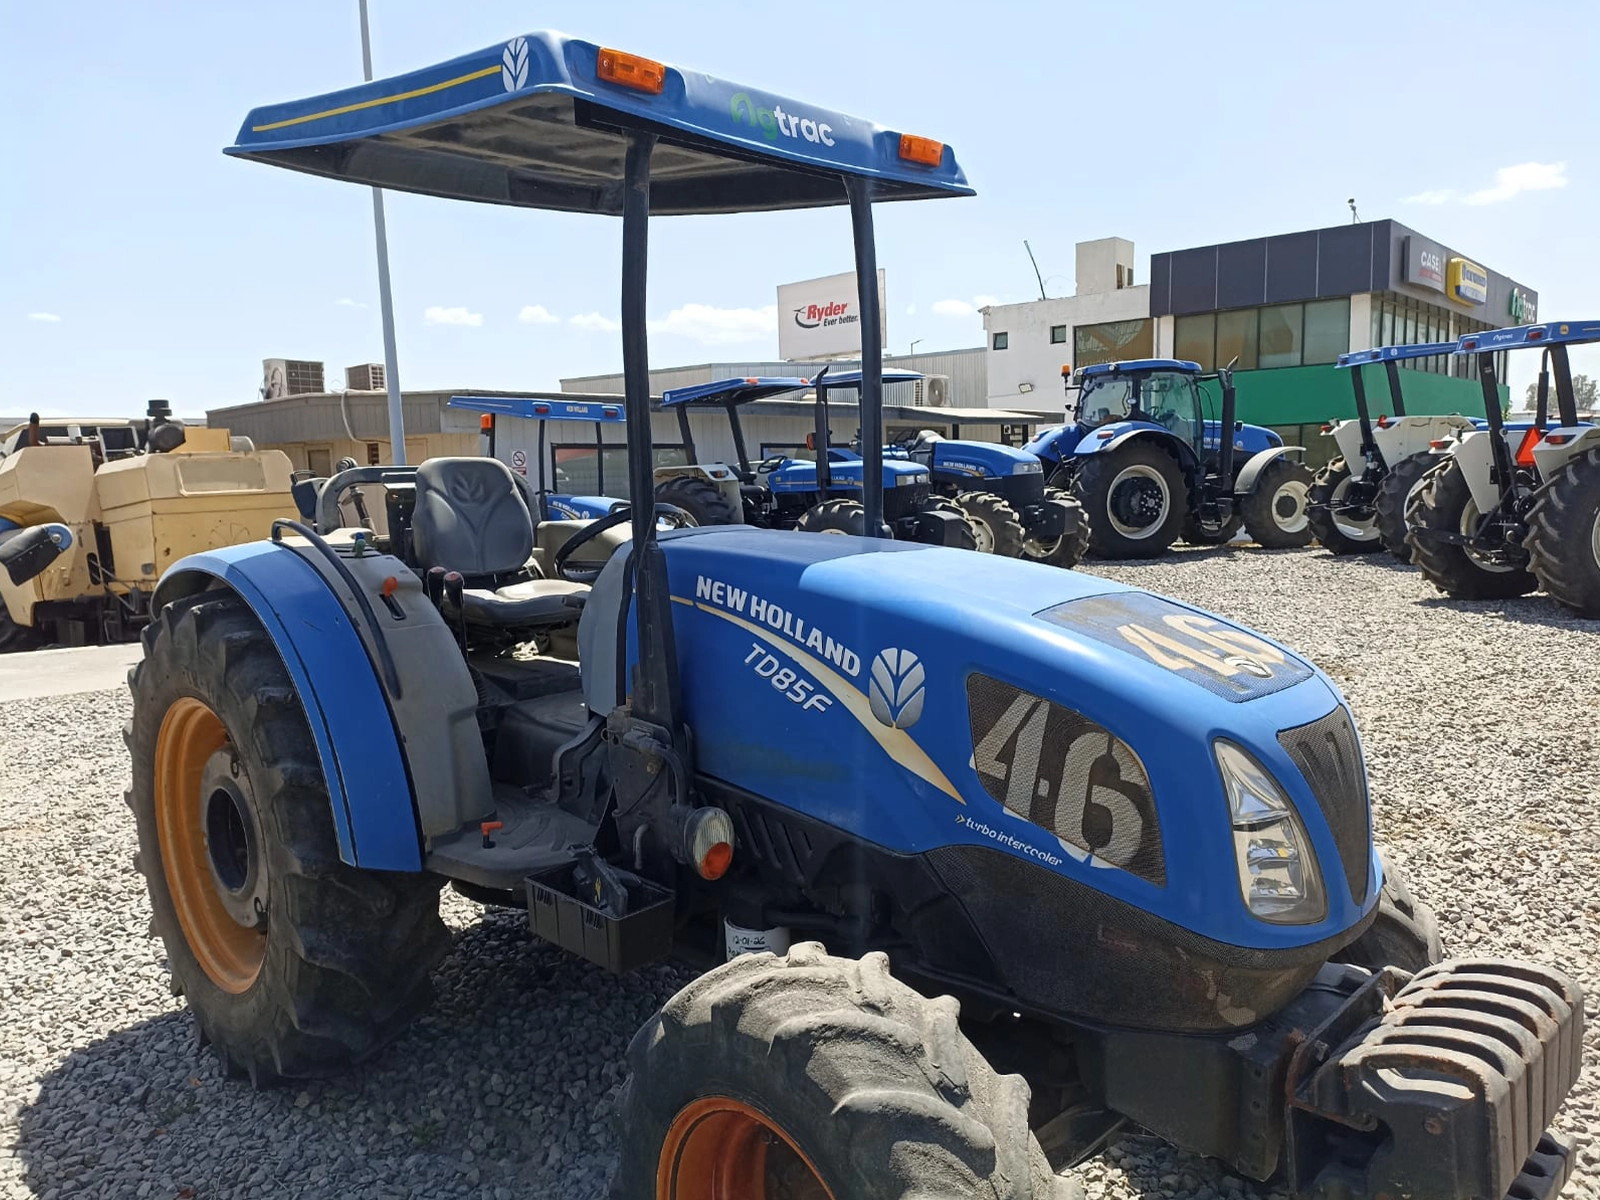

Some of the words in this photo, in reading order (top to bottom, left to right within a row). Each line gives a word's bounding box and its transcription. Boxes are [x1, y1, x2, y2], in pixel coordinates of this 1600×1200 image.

[730, 92, 836, 147] Agtrac
[1420, 250, 1440, 272] CASE
[806, 301, 848, 321] Ryder
[823, 318, 837, 327] Ever
[696, 575, 748, 612] NEW
[750, 594, 861, 677] HOLLAND
[744, 642, 833, 713] TD85F
[965, 817, 997, 838] turbo
[997, 831, 1063, 866] intercooler
